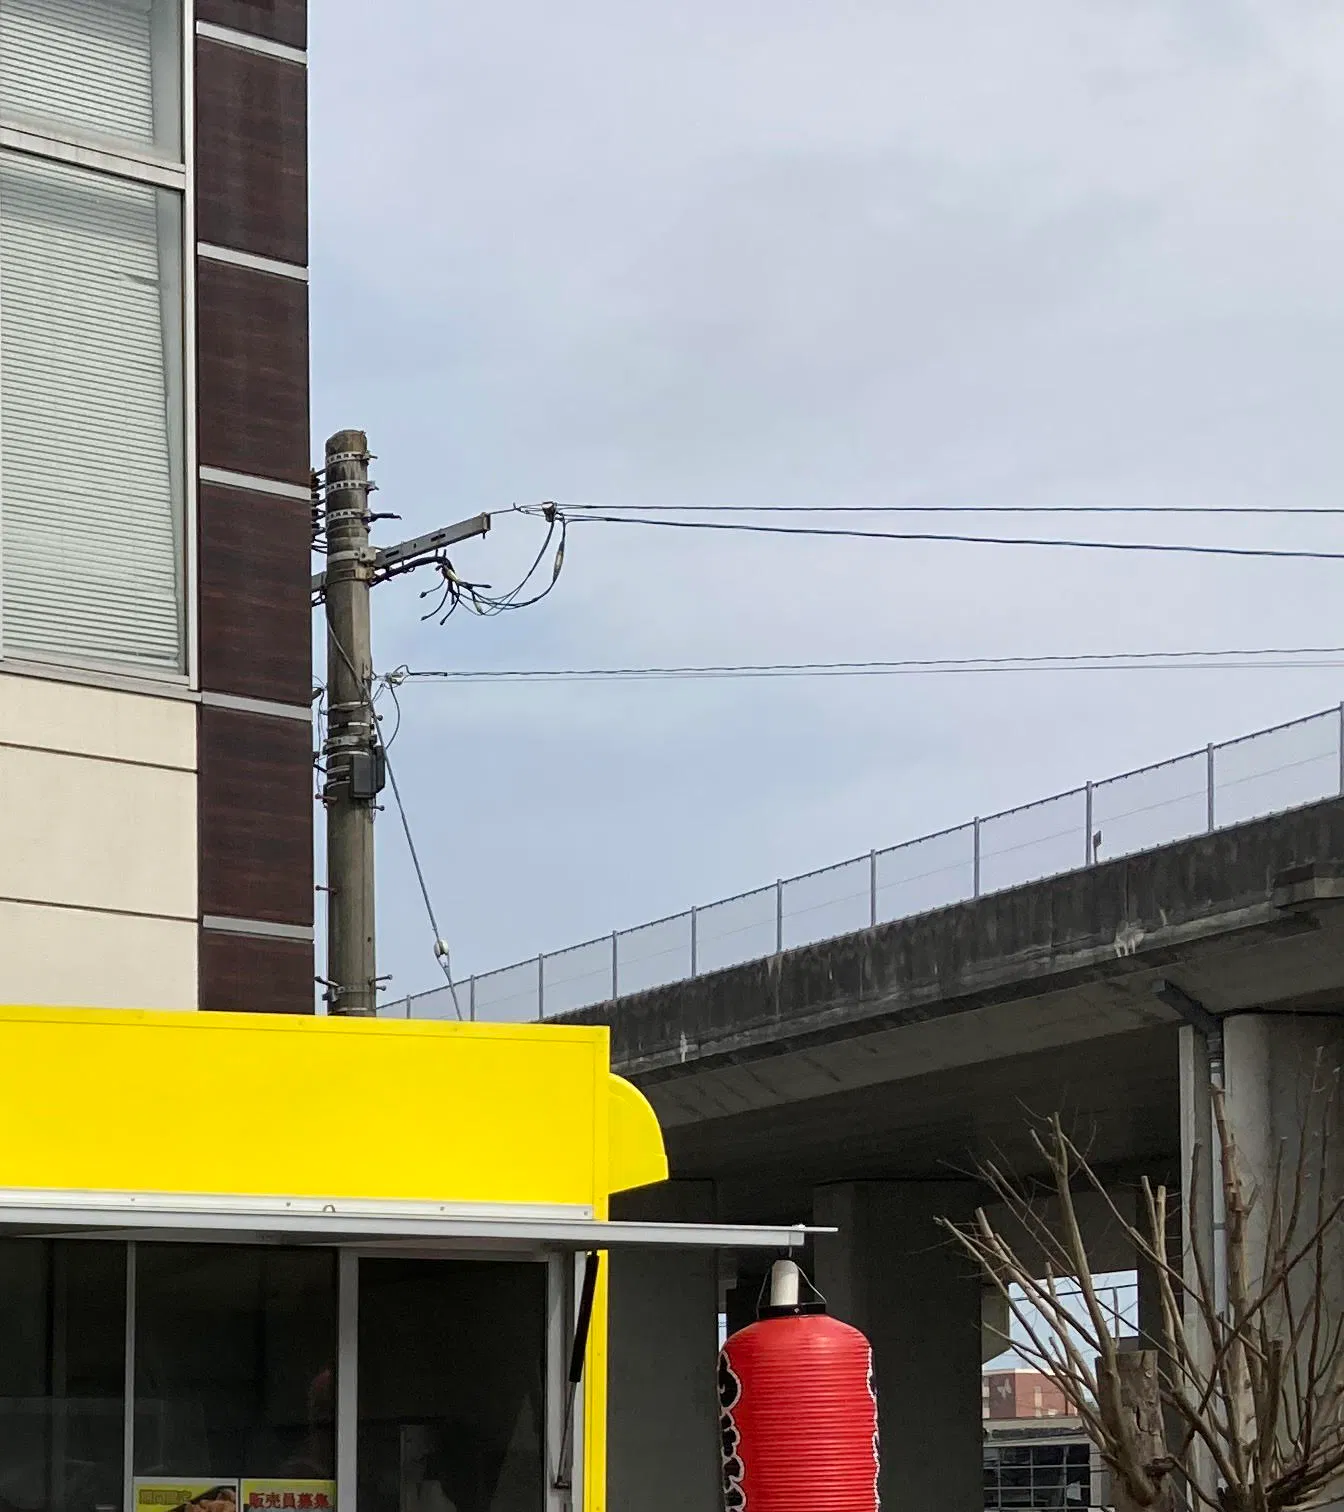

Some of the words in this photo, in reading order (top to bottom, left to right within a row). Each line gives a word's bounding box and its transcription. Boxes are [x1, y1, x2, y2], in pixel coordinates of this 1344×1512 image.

[249, 1492, 333, 1509] 販売員募集
